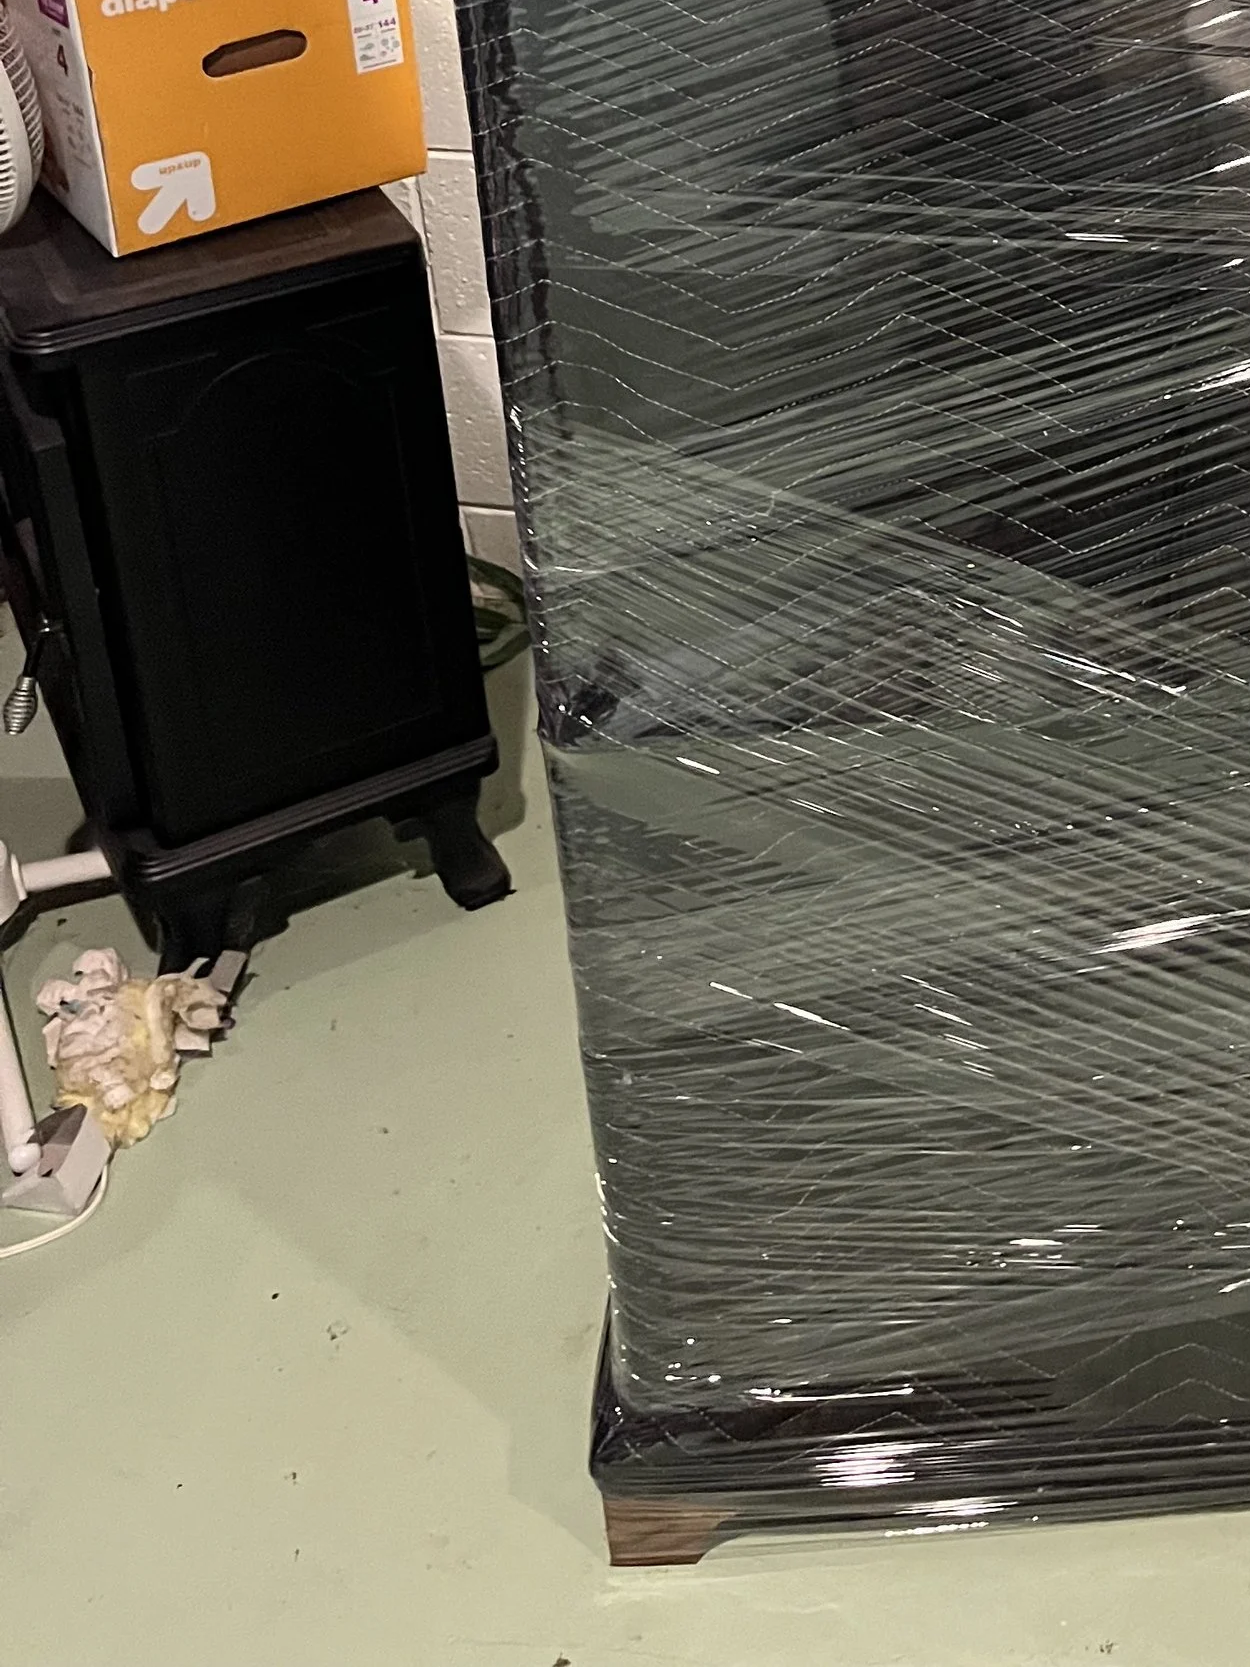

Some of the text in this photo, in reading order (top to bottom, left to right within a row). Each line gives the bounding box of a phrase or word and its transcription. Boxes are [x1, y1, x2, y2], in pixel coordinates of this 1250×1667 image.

[378, 17, 396, 28] 144
[56, 44, 69, 77] 4
[159, 158, 202, 175] up&up
